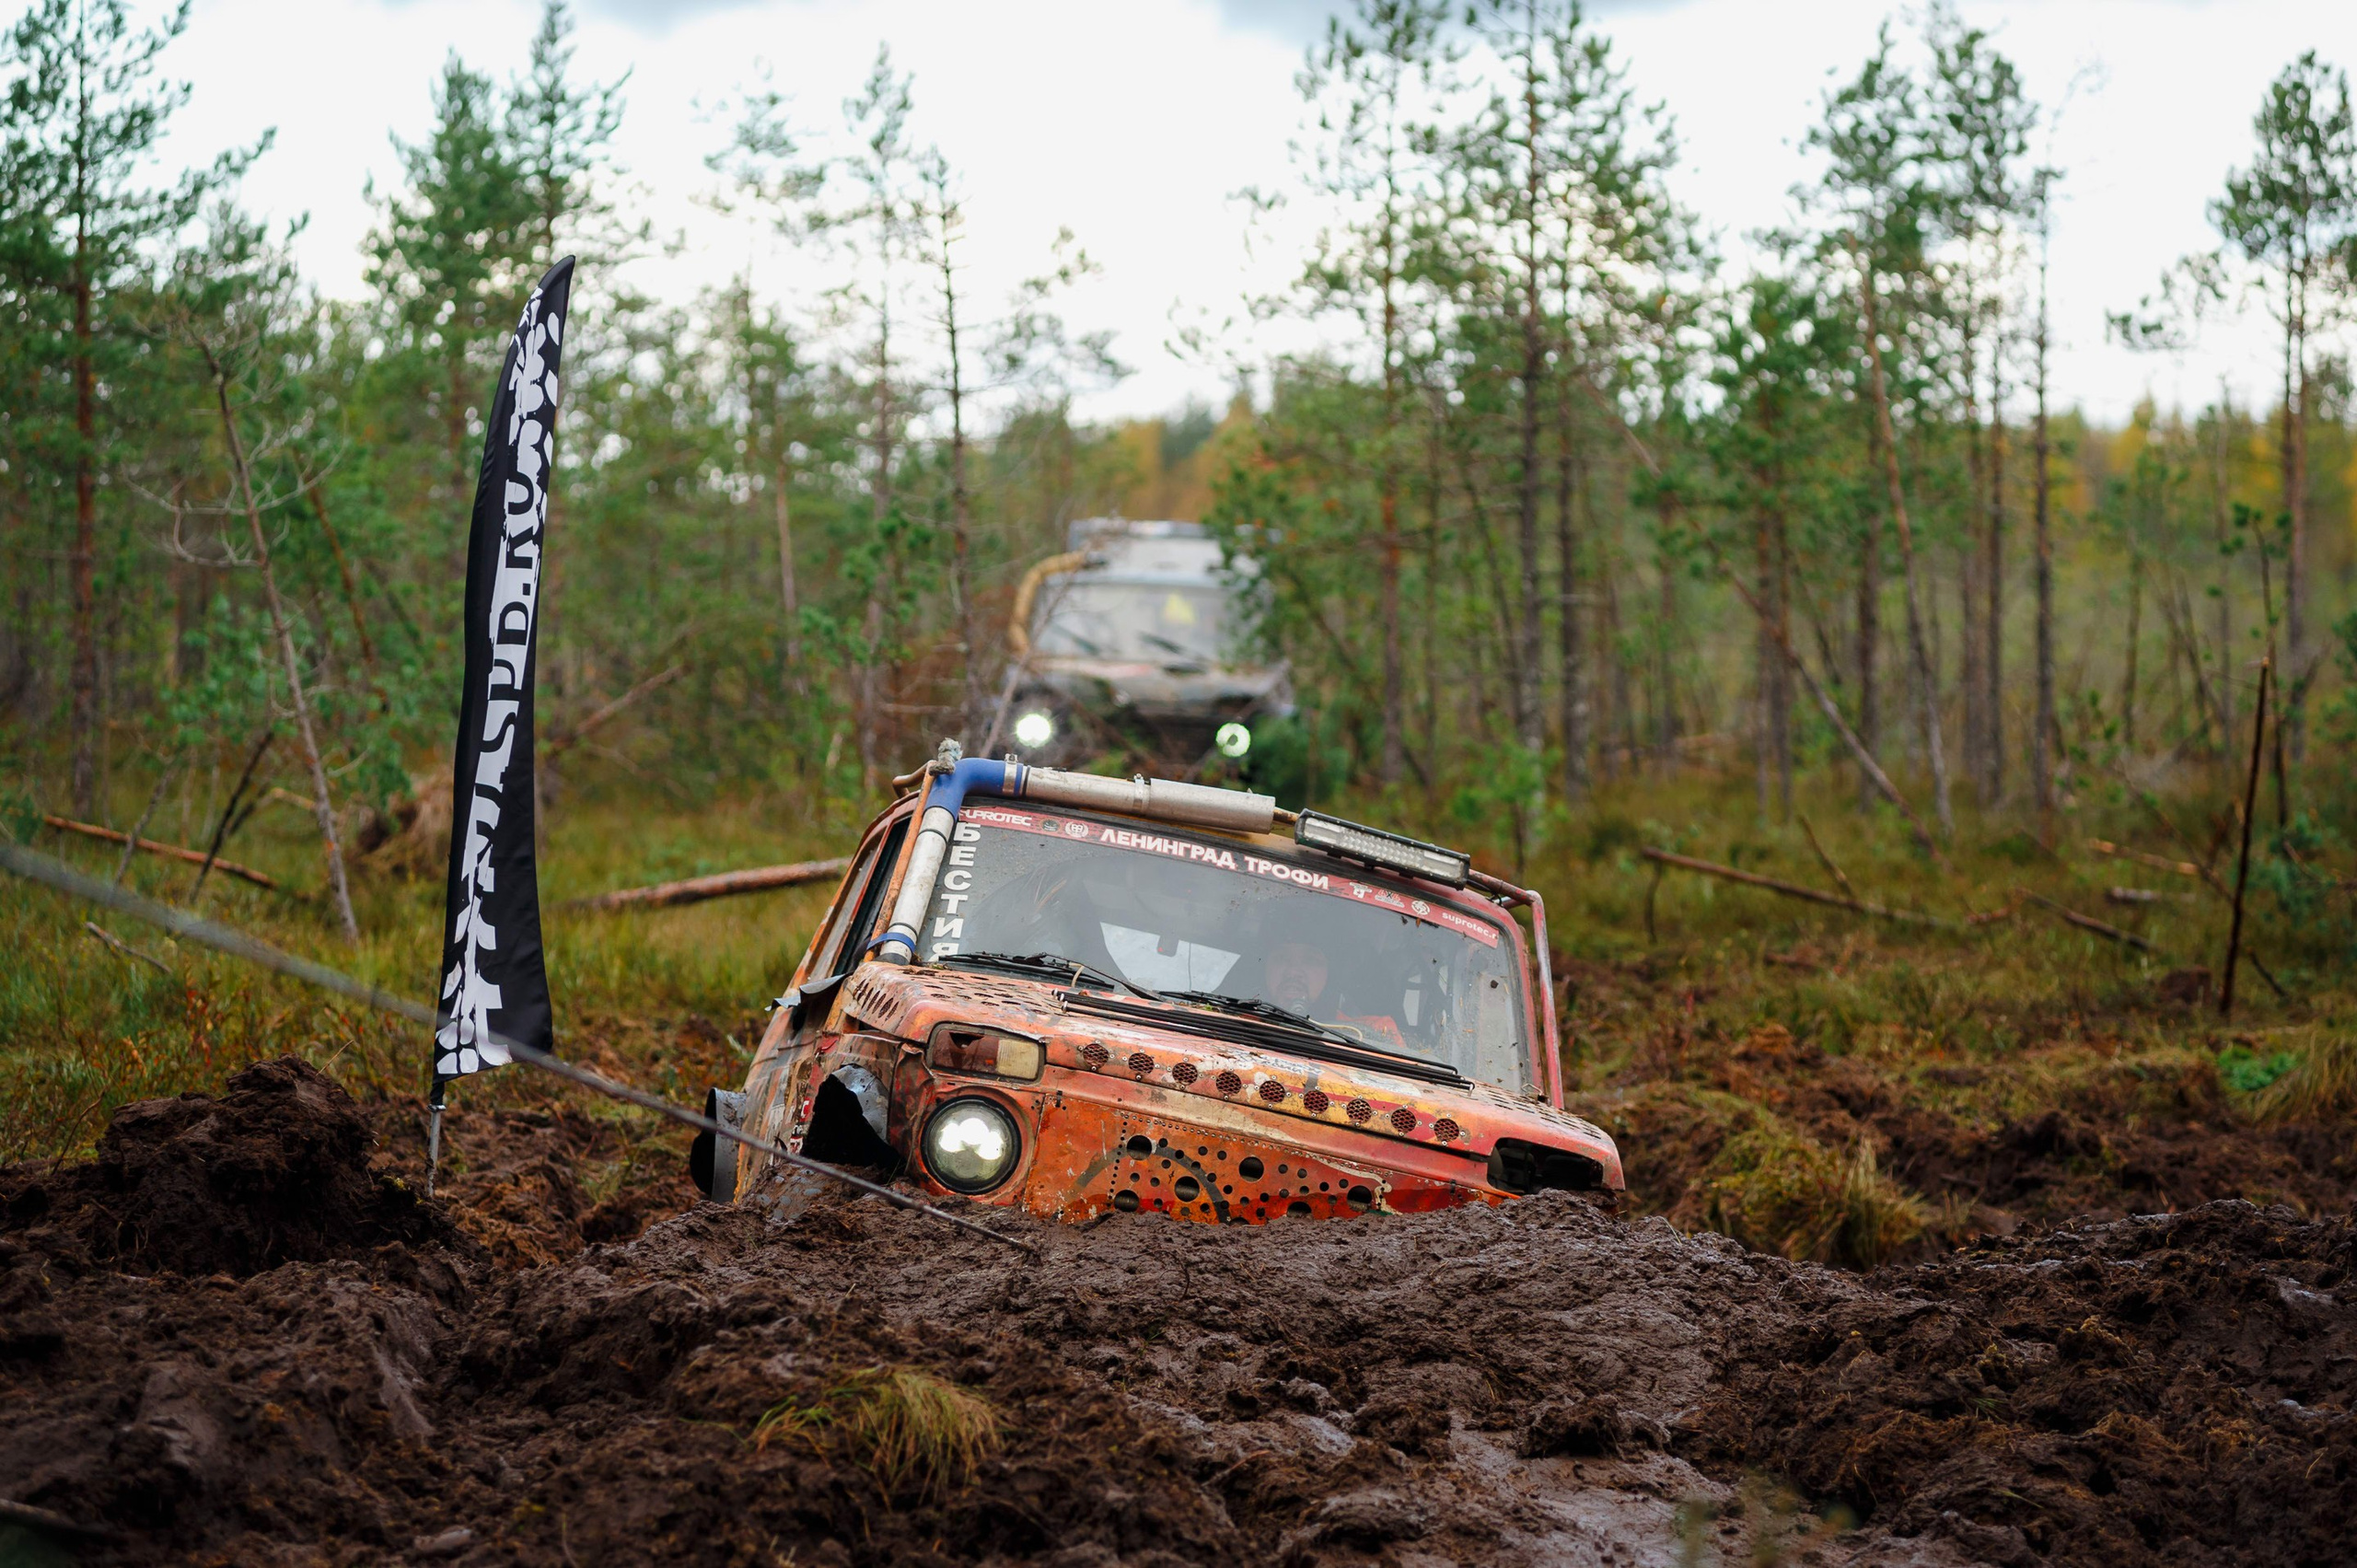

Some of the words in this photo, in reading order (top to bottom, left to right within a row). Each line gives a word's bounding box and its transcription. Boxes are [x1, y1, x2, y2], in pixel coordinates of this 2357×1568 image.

[928, 821, 981, 962] БЕСТИЯ
[1100, 829, 1237, 870] ЛЕНИНГРАД
[1244, 856, 1329, 890] ТРОФИ
